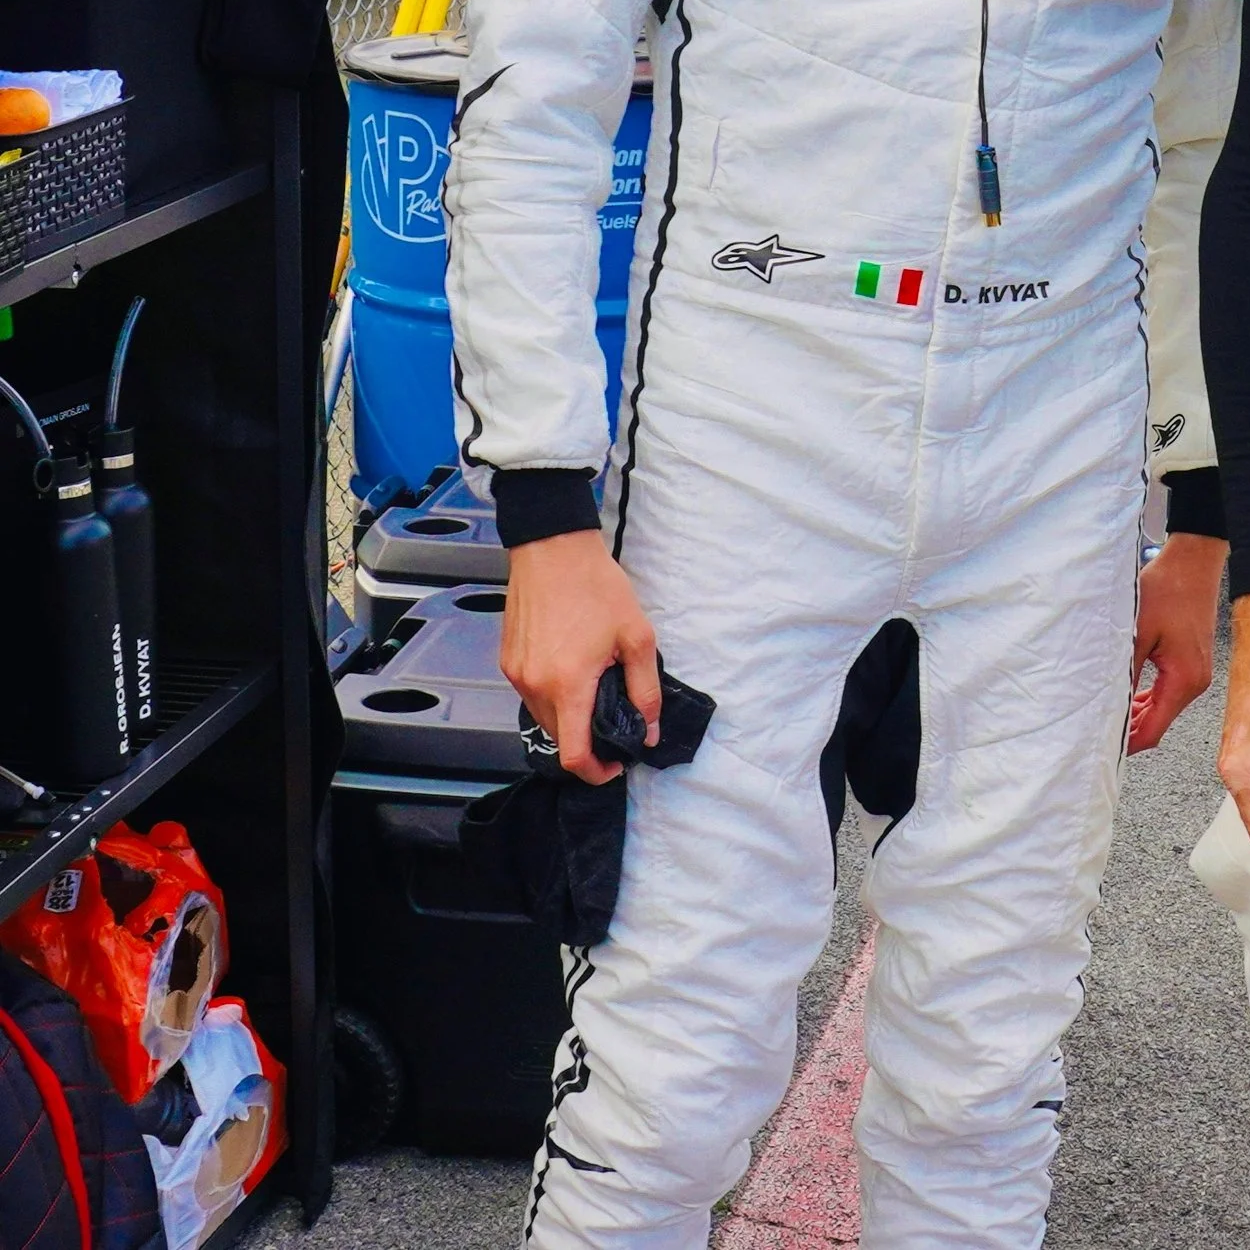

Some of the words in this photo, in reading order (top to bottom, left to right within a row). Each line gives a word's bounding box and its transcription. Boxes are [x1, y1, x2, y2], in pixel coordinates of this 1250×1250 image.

[406, 189, 442, 226] Rac
[944, 283, 968, 304] D.
[978, 280, 1050, 305] KVYAT
[136, 638, 151, 698] KVYAT
